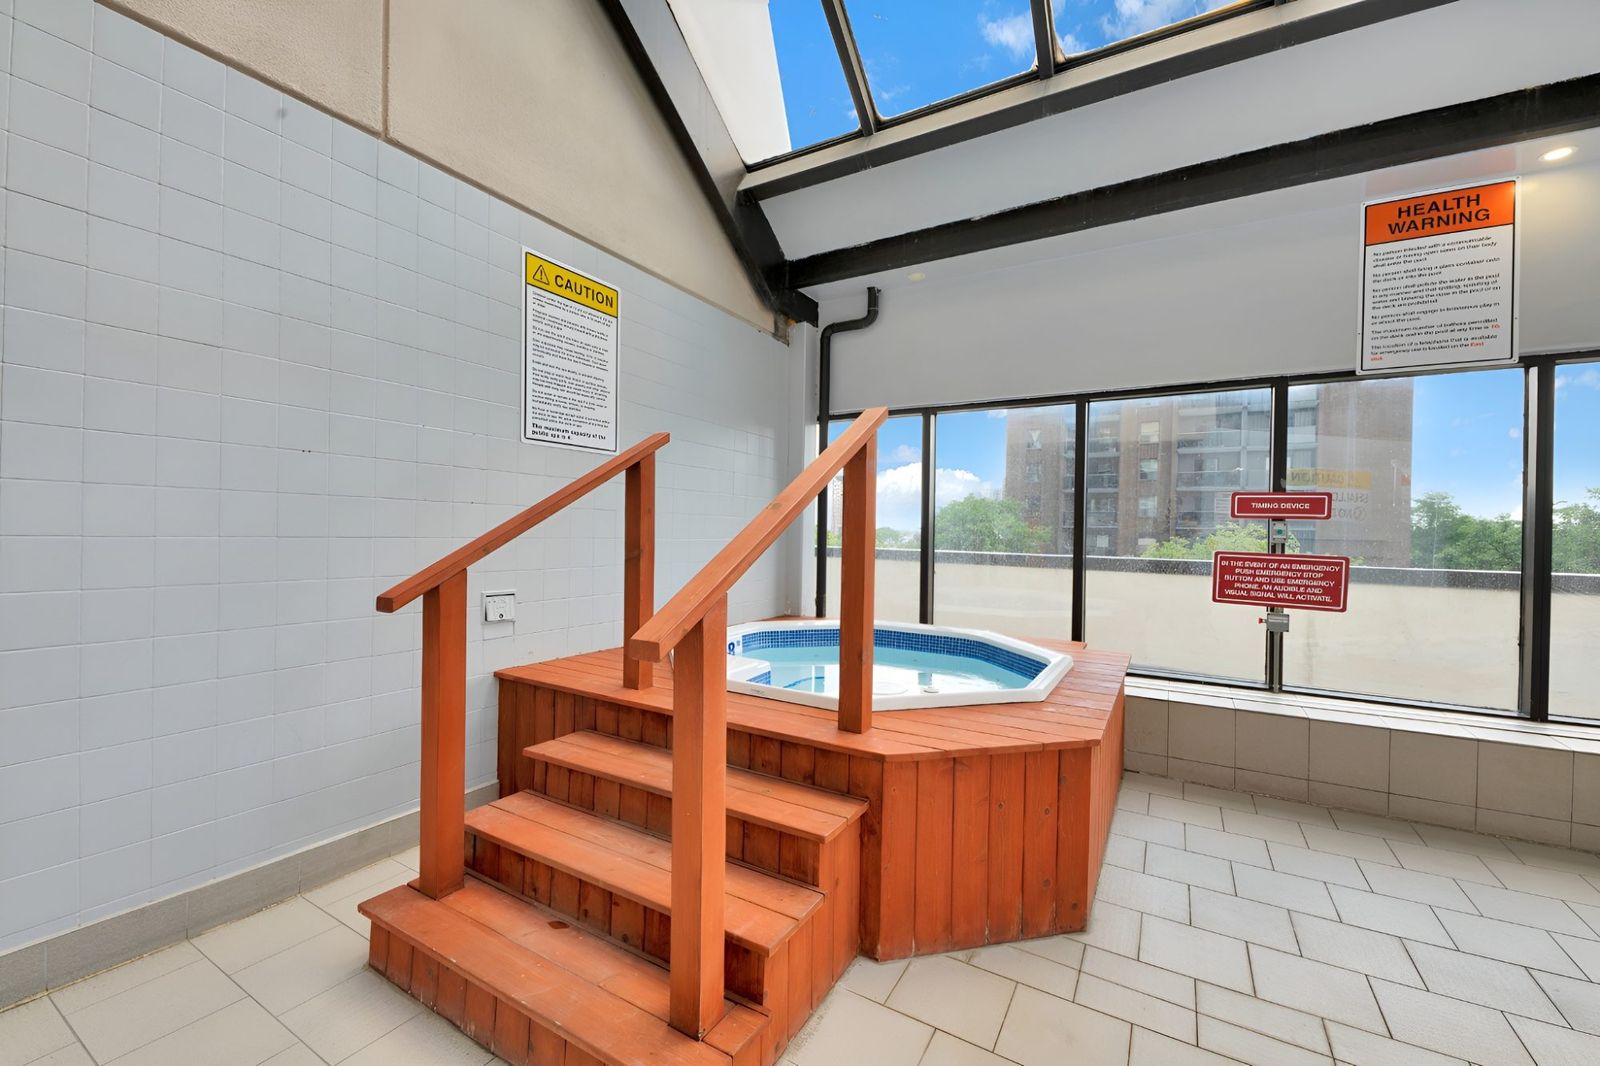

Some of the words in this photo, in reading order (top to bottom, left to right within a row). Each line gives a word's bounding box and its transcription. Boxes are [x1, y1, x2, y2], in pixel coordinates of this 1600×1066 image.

[1397, 194, 1481, 219] HEALTH
[1388, 208, 1491, 235] WARNING
[554, 275, 613, 308] CAUTION
[1292, 564, 1340, 572] EMERGENCY
[1256, 569, 1302, 578] EMERGENCY
[1287, 578, 1334, 586] EMERGENCY
[1250, 590, 1276, 598] SIGNAL
